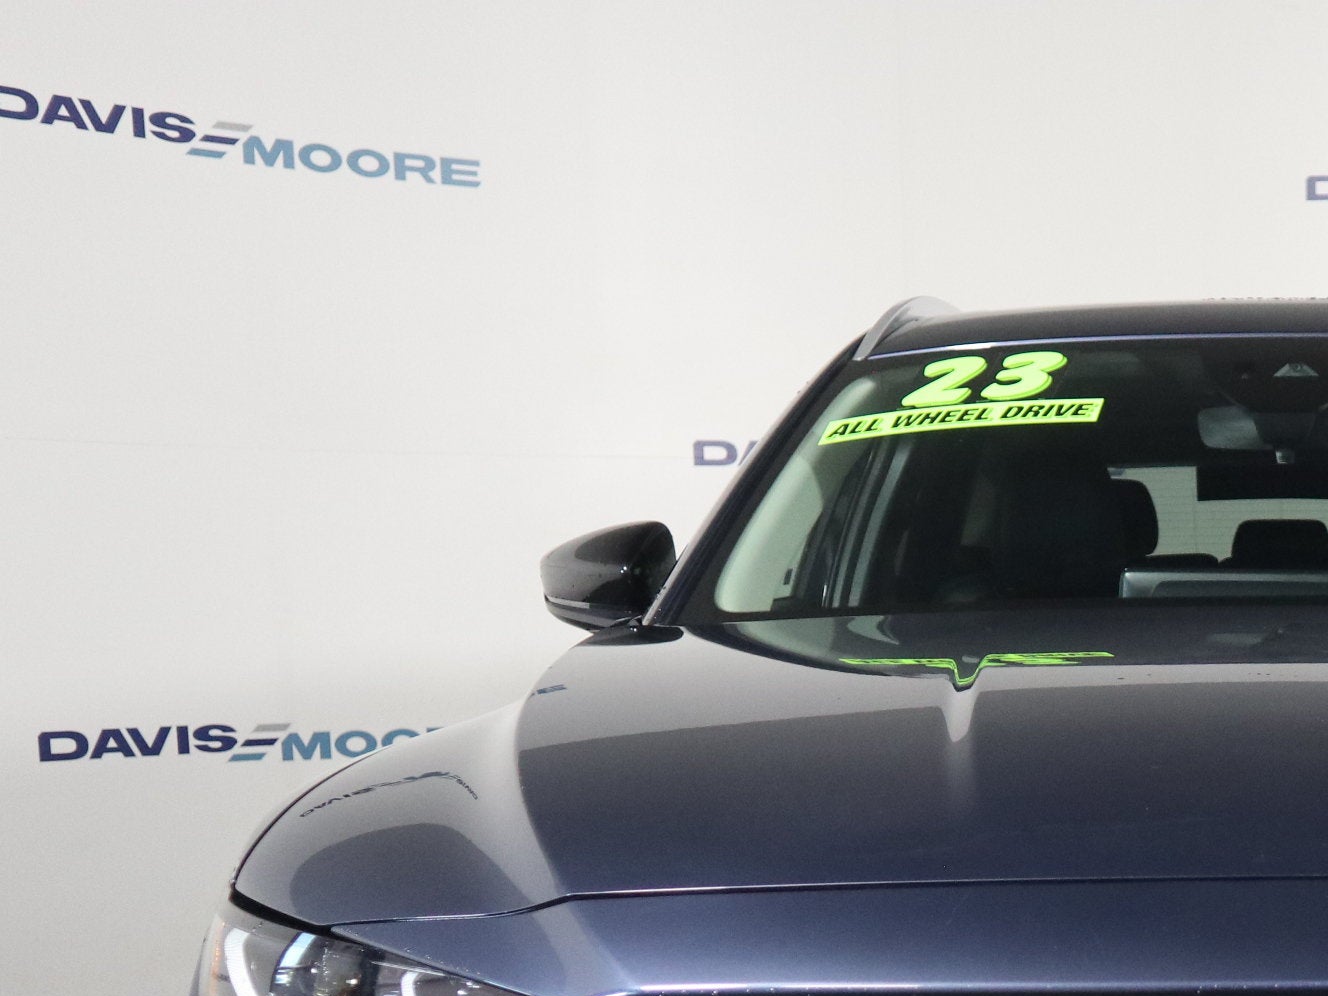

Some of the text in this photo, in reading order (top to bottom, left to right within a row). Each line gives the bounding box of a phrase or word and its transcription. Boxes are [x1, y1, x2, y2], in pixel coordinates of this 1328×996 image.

[0, 85, 481, 188] DAVIS MOORE
[901, 351, 1068, 408] 23
[827, 402, 1094, 439] ALL WHEEL DRIVE
[38, 724, 446, 762] DAVIS MO
